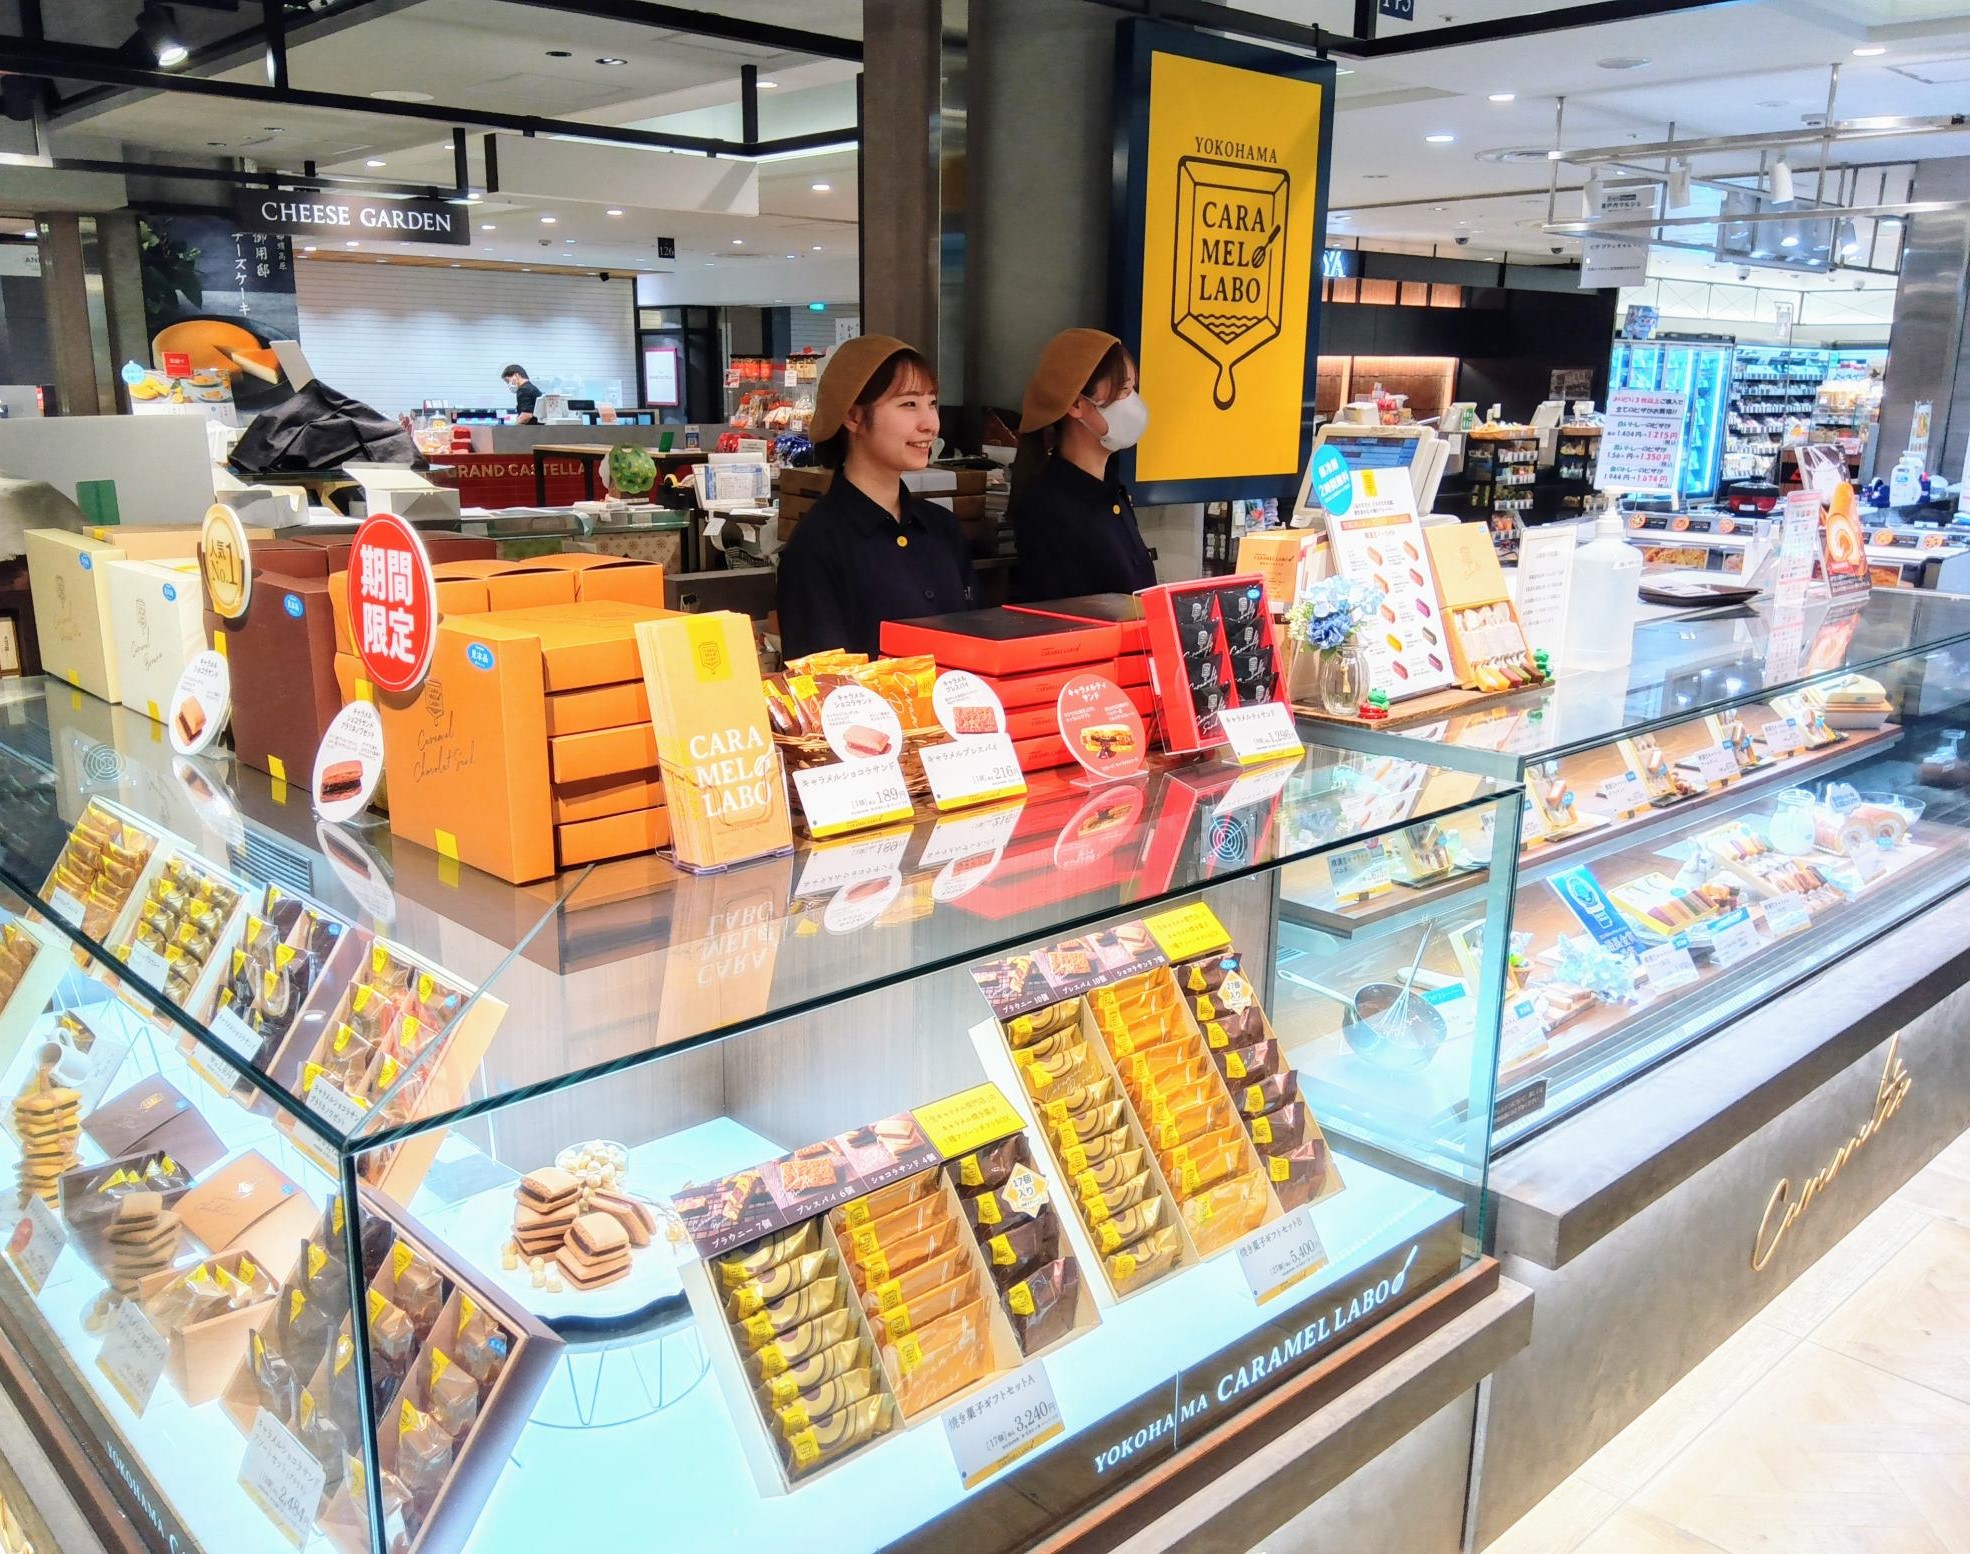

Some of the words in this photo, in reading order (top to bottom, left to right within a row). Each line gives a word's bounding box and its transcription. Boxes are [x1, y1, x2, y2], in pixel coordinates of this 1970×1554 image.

[1195, 136, 1278, 164] YOKOHAMA
[261, 202, 350, 225] CHEESE
[360, 207, 451, 232] GARDEN
[1202, 201, 1266, 232] CARA
[1200, 238, 1249, 267] MEL
[1199, 275, 1261, 303] LABO
[447, 464, 503, 478] GRAND
[209, 540, 227, 560] 人気
[360, 544, 414, 606] 期間
[362, 602, 416, 665] 限定
[834, 699, 873, 708] ショコラサンド
[838, 692, 865, 700] キャラメル
[689, 725, 765, 760] CARA
[928, 743, 997, 762] キャラメルプレスパイ
[695, 756, 754, 790] MEL
[802, 761, 895, 788] キャラメルショコラサンド
[702, 781, 772, 819] LABO
[1062, 981, 1092, 994] プレスパイ
[1092, 974, 1108, 985] 10個
[1002, 1000, 1033, 1014] ブラウニー
[1034, 994, 1050, 1004] 10個
[870, 1159, 920, 1185] ショコラサンド
[920, 1153, 938, 1165] 4個
[1013, 1174, 1033, 1185] 17個
[796, 1194, 837, 1215] プレスパイ
[838, 1185, 856, 1199] 6個
[1020, 1188, 1034, 1198] 入り
[711, 1227, 754, 1250] ブラウニー
[755, 1218, 774, 1232] 7個
[1239, 1216, 1303, 1257] 焼き菓子ギフトセットB
[1094, 1393, 1208, 1474] YOKOHAMA
[1217, 1318, 1332, 1402] CARAMEL
[1333, 1279, 1391, 1332] LABO
[948, 1374, 1036, 1432] 焼き菓子ギフトセットA
[106, 1440, 165, 1539] YOKOHAMA
